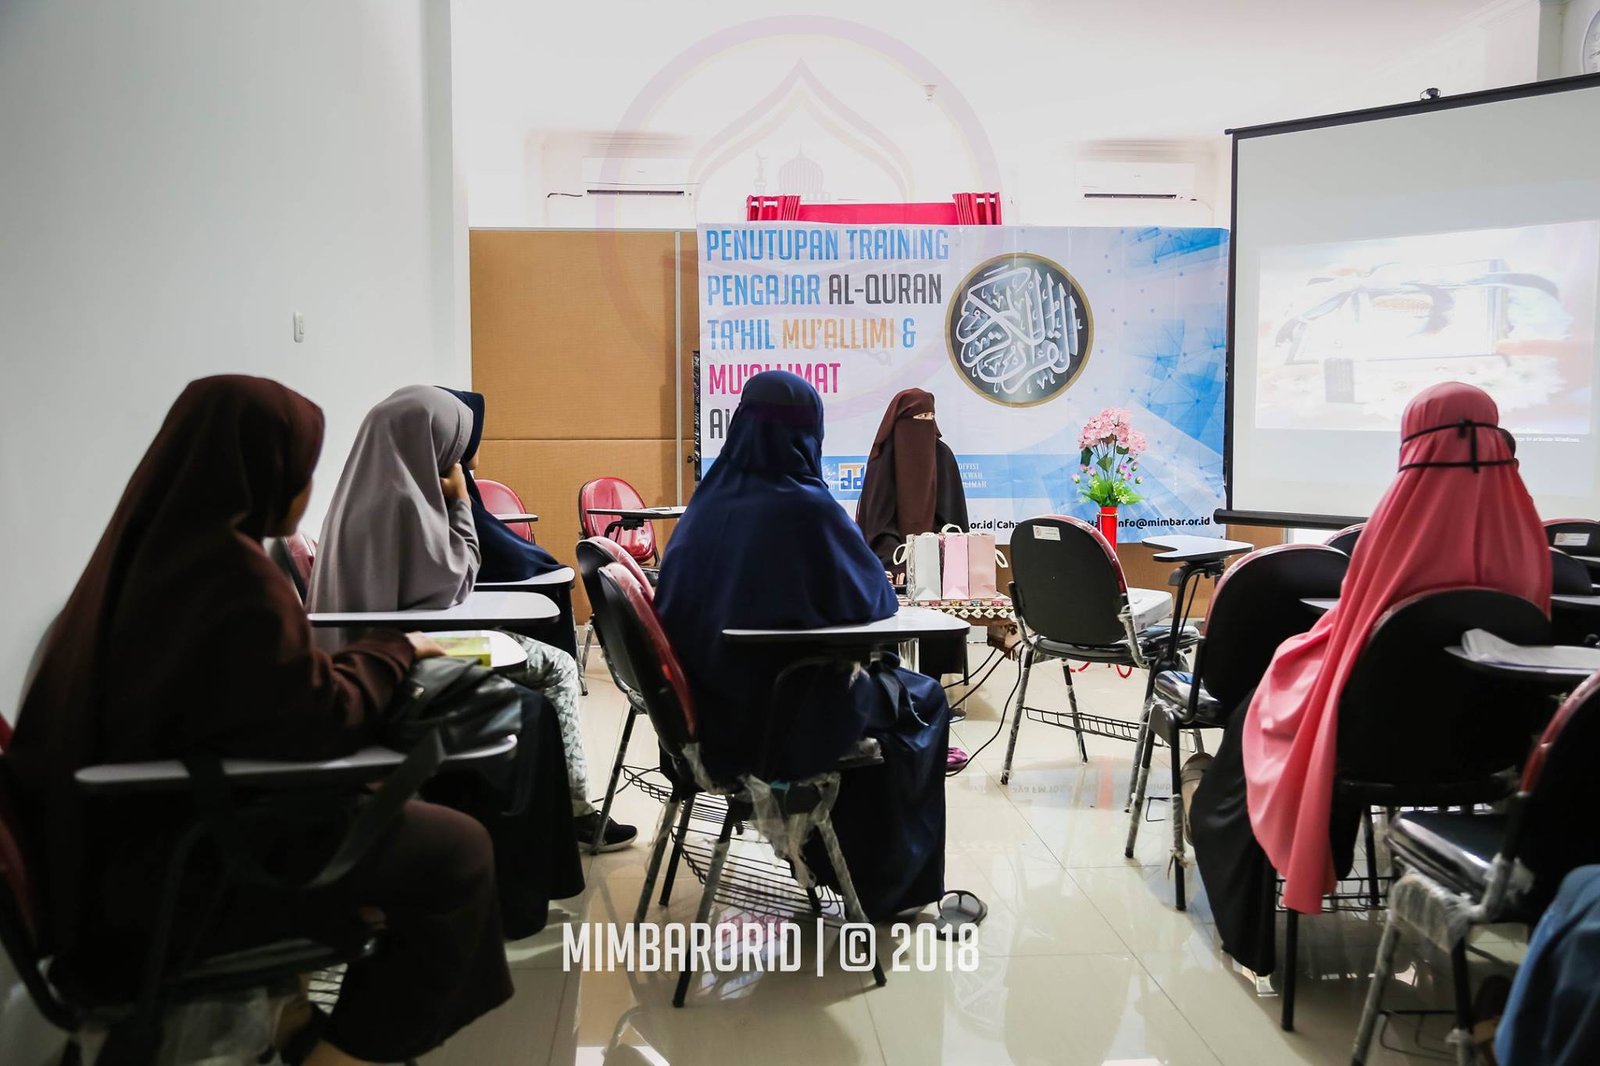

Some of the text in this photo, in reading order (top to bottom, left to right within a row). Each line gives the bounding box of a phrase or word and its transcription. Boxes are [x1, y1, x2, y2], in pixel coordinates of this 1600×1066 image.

[707, 229, 949, 261] PENUTUPAN TRAINING
[707, 273, 942, 306] PENGAJAR AL-QURAN
[707, 319, 775, 350] TA'HIL
[902, 318, 916, 348] &
[1117, 517, 1211, 529] nfo@mimbar.or.id
